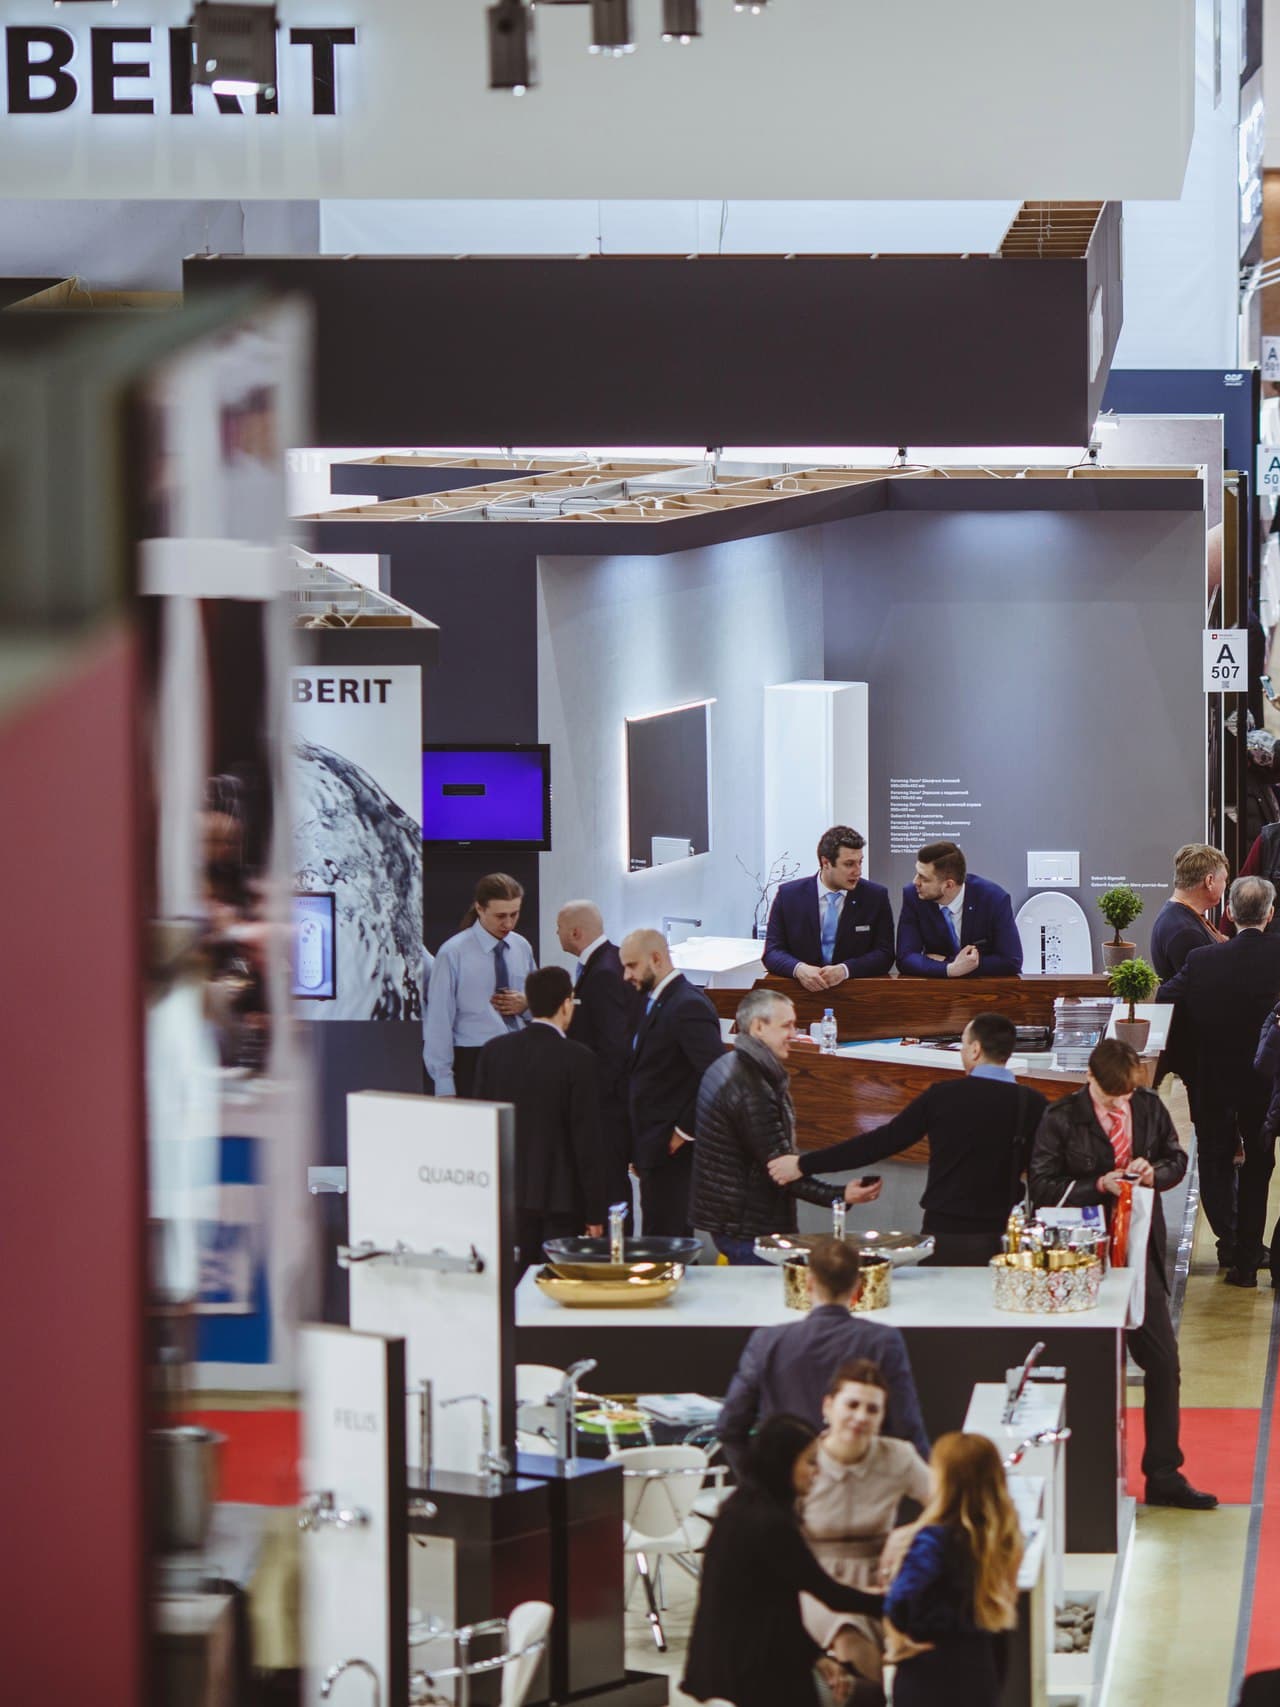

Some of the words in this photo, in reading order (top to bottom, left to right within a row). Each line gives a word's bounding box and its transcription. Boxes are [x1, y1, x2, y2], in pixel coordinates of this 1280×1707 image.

[1267, 347, 1278, 361] A
[1216, 644, 1236, 663] A
[1211, 666, 1240, 679] 507
[292, 679, 392, 703] BERIT
[417, 1165, 489, 1188] QUADRO
